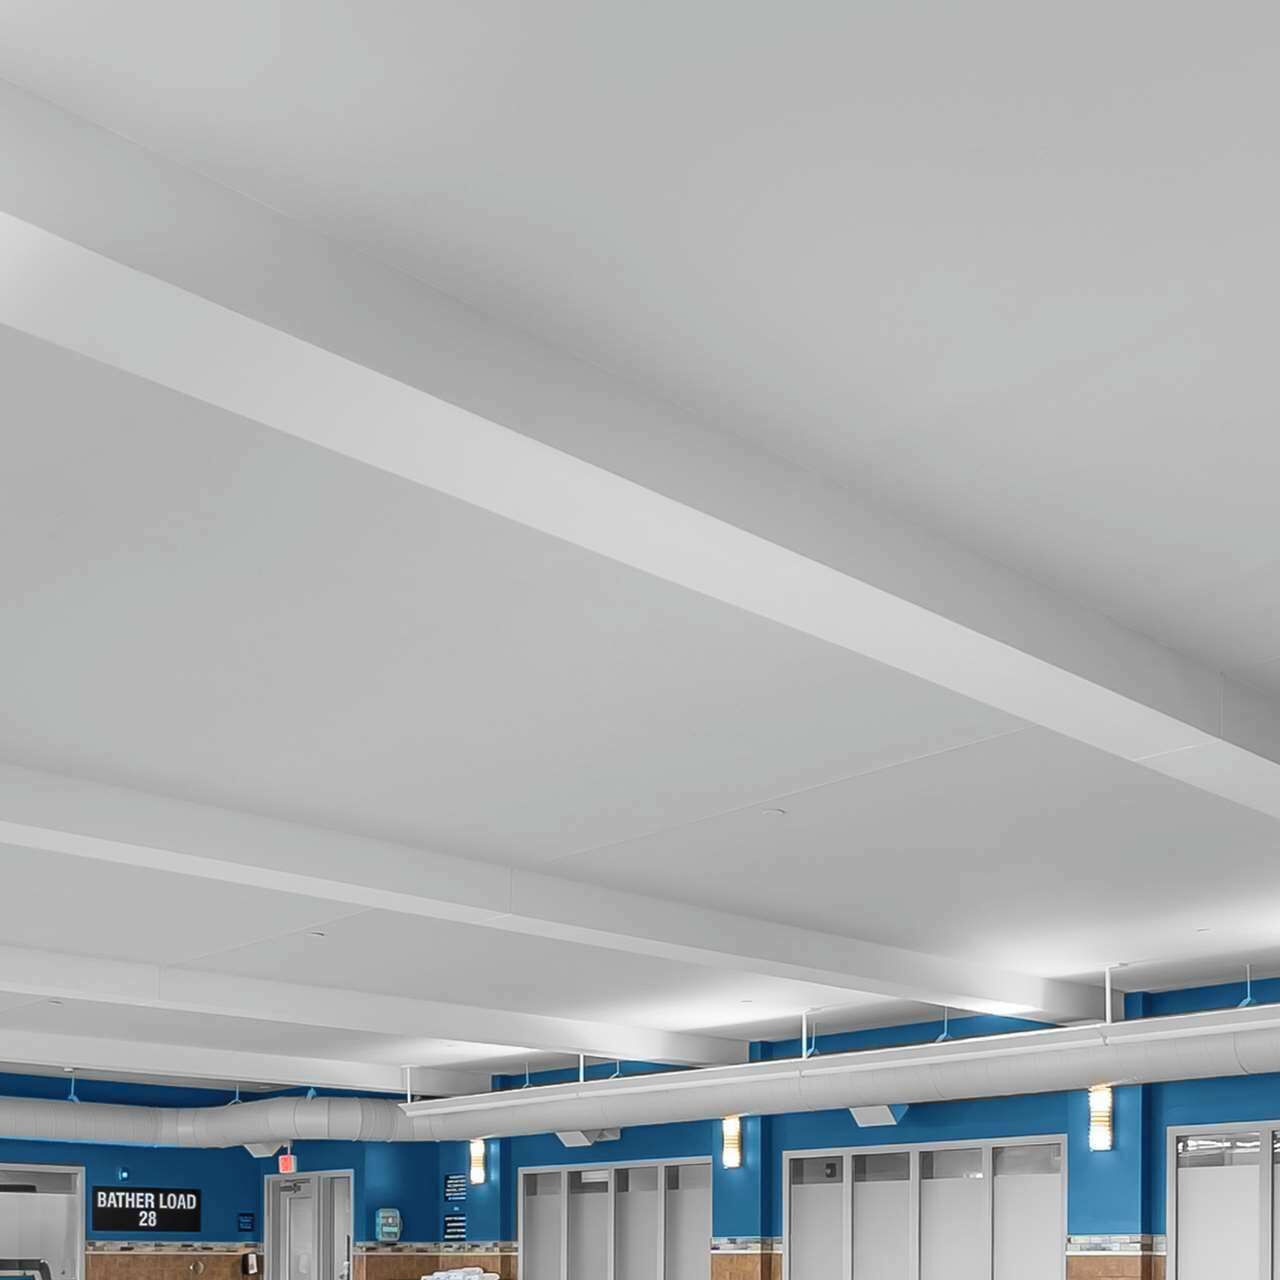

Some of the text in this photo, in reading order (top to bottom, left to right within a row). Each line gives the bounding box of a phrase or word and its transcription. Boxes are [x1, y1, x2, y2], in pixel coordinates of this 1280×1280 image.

[97, 1191, 197, 1210] BATHER LOAD
[138, 1210, 157, 1227] 28
